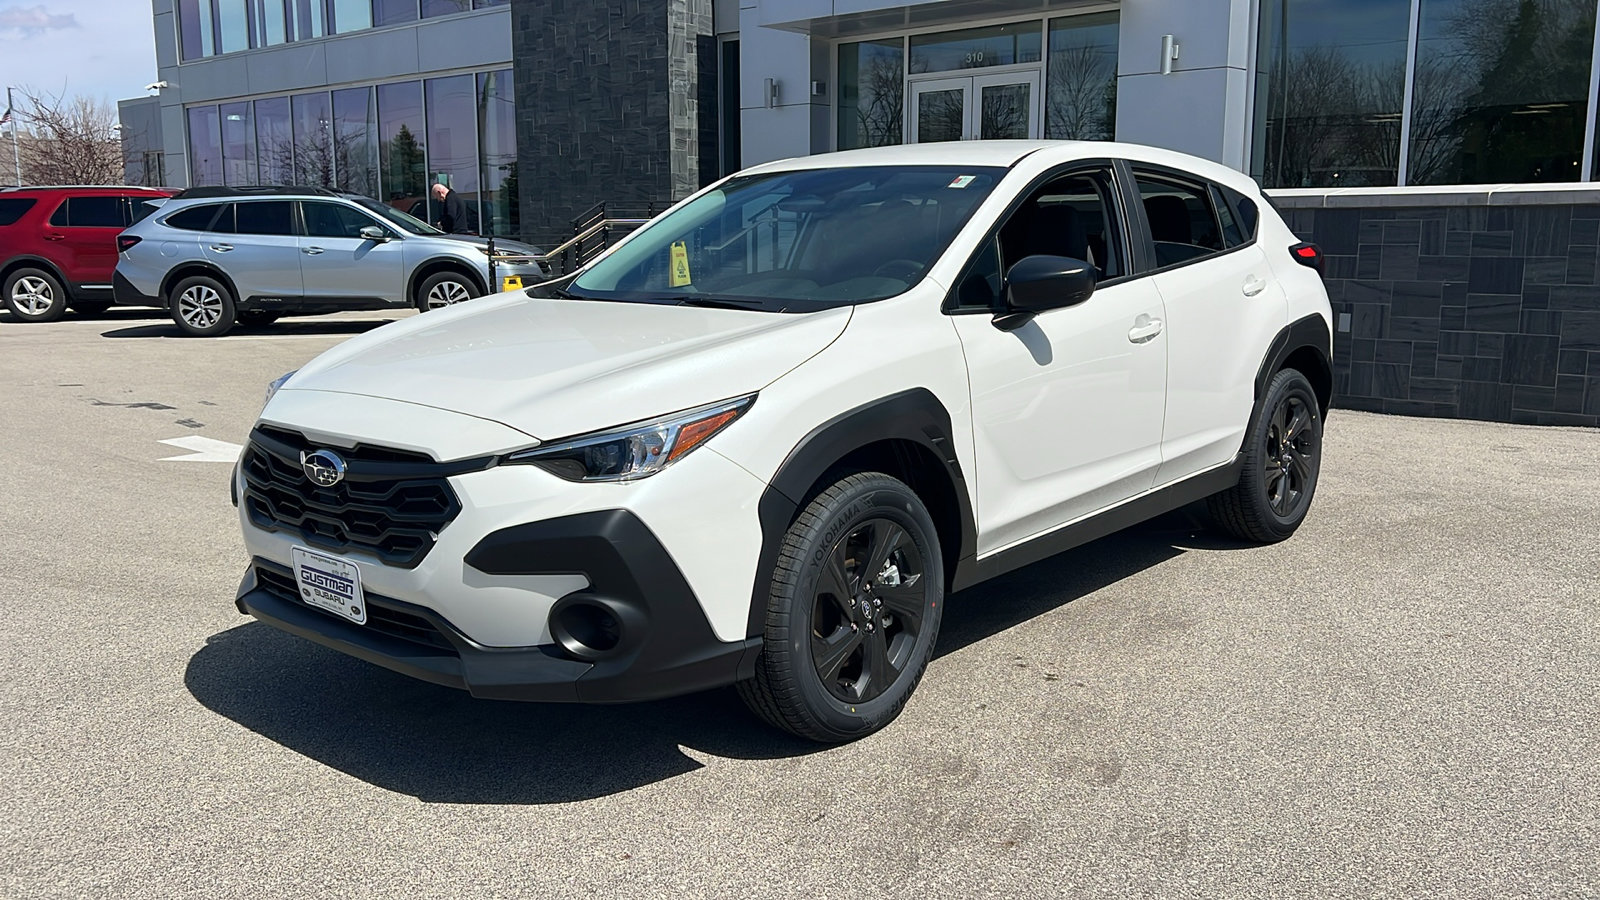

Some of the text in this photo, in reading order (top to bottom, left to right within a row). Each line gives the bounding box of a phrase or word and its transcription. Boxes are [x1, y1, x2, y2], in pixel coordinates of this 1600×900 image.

[966, 51, 983, 63] 310
[811, 504, 861, 568] YOKOHAMA
[314, 588, 345, 605] SUBARU
